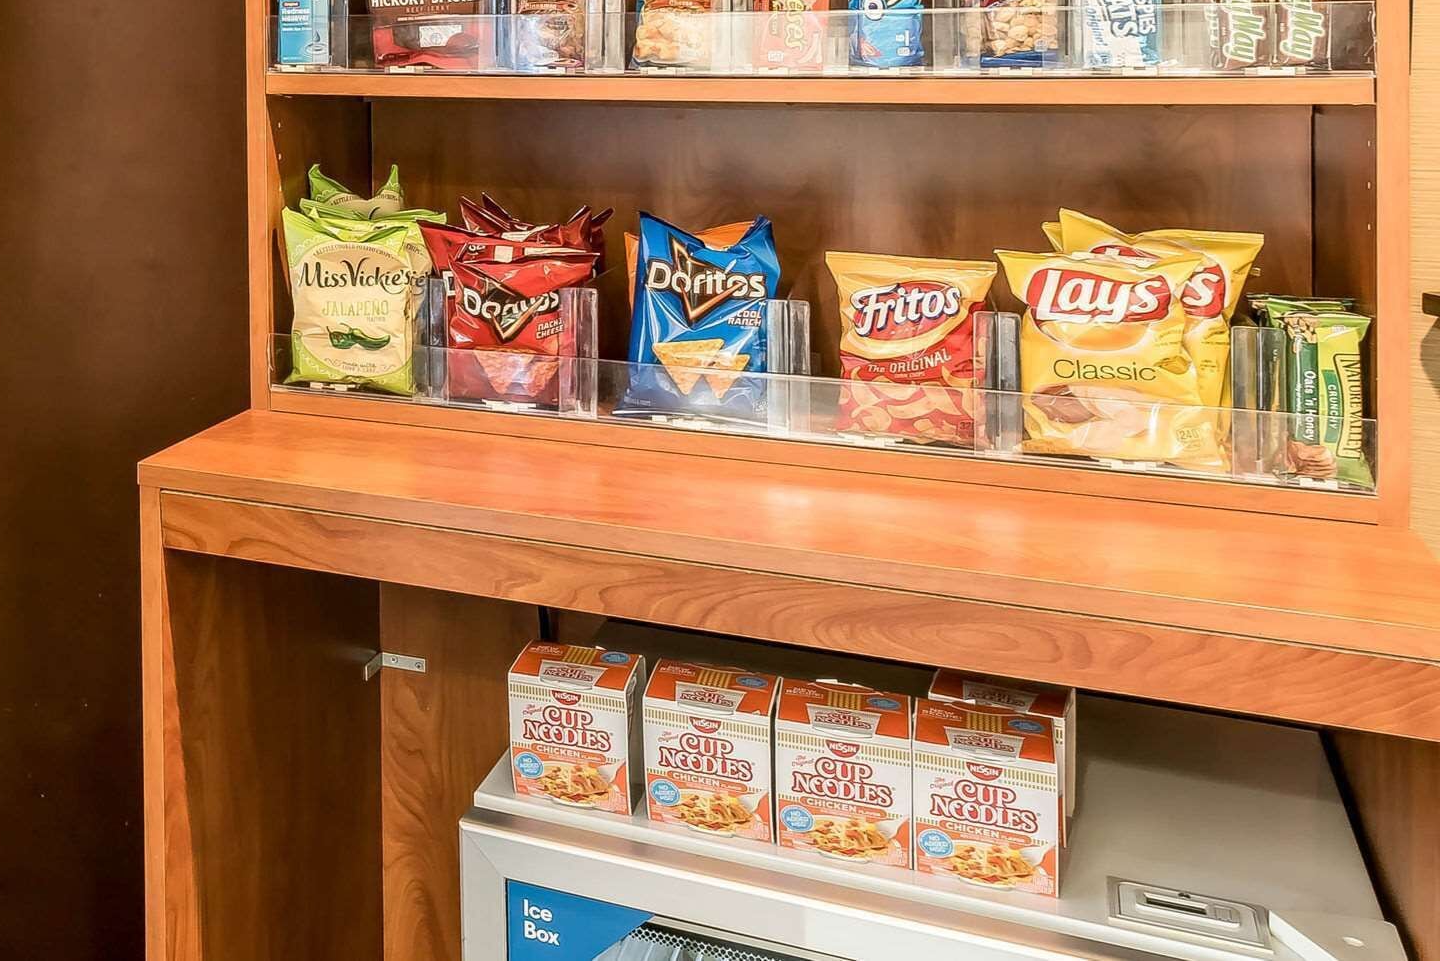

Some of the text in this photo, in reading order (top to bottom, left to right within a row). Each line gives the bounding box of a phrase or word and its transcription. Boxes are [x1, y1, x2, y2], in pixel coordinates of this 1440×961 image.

[298, 262, 347, 289] Miss
[646, 261, 767, 299] Doritos
[321, 296, 390, 316] JALAPEÑO
[732, 310, 762, 319] COOL
[851, 284, 962, 337] Fritos
[535, 324, 565, 339] CHEESE
[727, 317, 762, 327] RANCH
[867, 347, 953, 375] The ORIGINAL
[1053, 358, 1157, 382] Classic
[1303, 370, 1317, 393] Oats
[1341, 358, 1361, 408] NATURE
[1327, 384, 1338, 430] CRUNCHY
[1303, 408, 1317, 442] Honey
[554, 692, 579, 702] NISSIN
[542, 704, 593, 728] CUP
[693, 718, 719, 729] NISSIN
[522, 719, 612, 753] NOODLES
[678, 731, 734, 757] CUP
[828, 742, 857, 754] NISSIN
[536, 745, 581, 759] CHICKEN
[658, 745, 753, 782] NOODLES
[672, 772, 719, 787] CHICKEN
[814, 756, 873, 784] CUP
[969, 764, 998, 778] NISSIN
[791, 770, 894, 808] NOODLES
[953, 778, 1017, 806] CUP
[806, 797, 857, 812] CHICKEN
[929, 792, 1040, 834] NOODLES
[945, 821, 1000, 839] CHICKEN
[523, 898, 553, 922] Ice
[523, 920, 560, 946] Box
